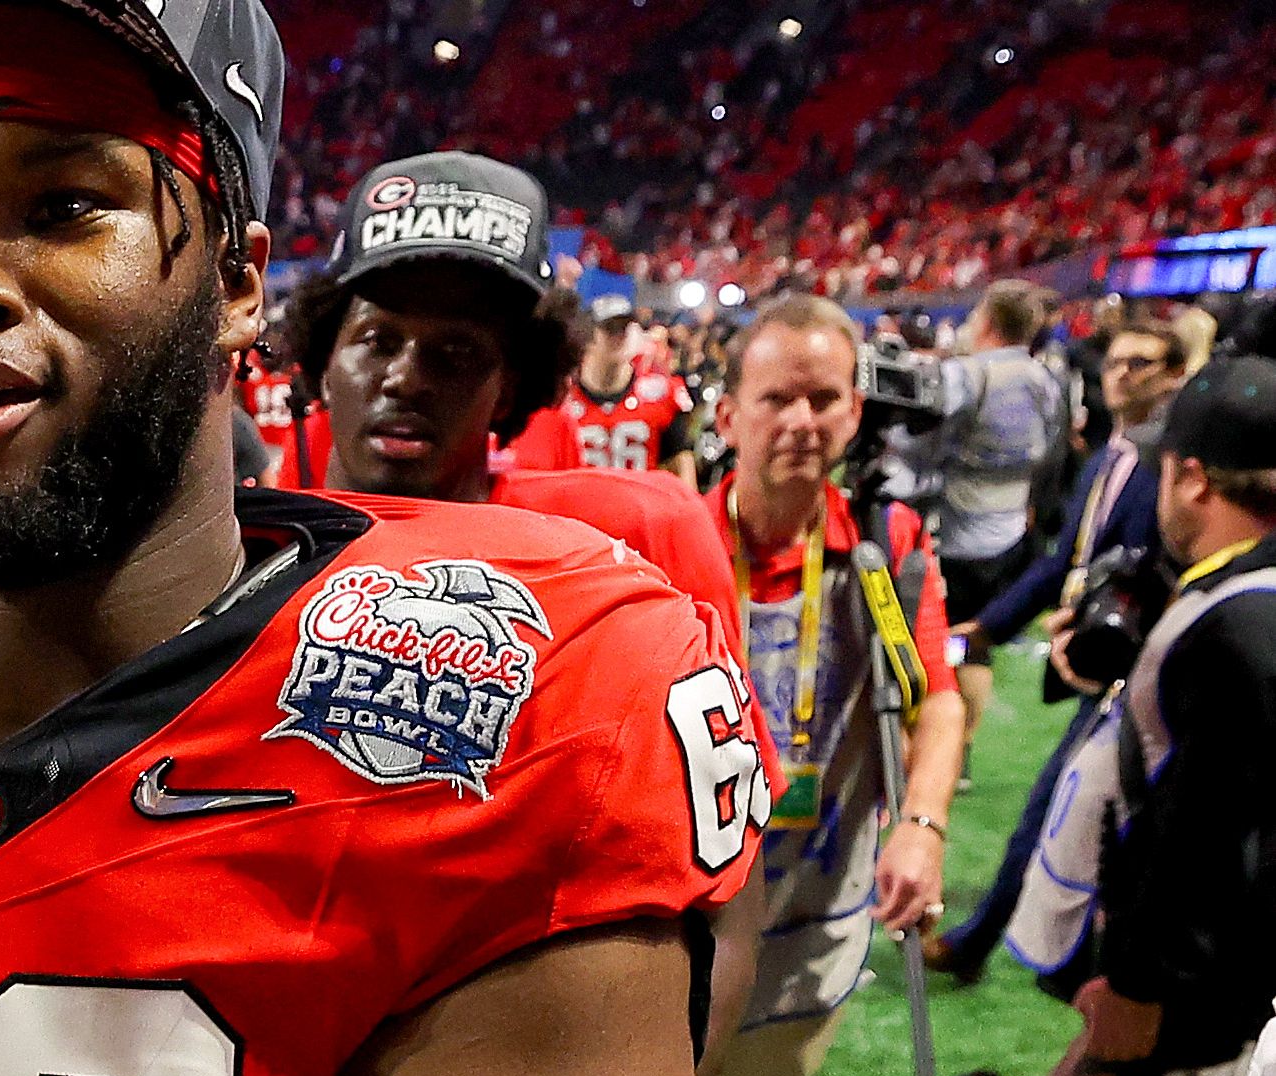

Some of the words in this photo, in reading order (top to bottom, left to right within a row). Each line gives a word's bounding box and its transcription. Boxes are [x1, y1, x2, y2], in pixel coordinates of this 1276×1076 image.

[360, 206, 532, 257] CHAMPS
[291, 647, 511, 752] PEACH
[325, 705, 450, 755] BOWL
